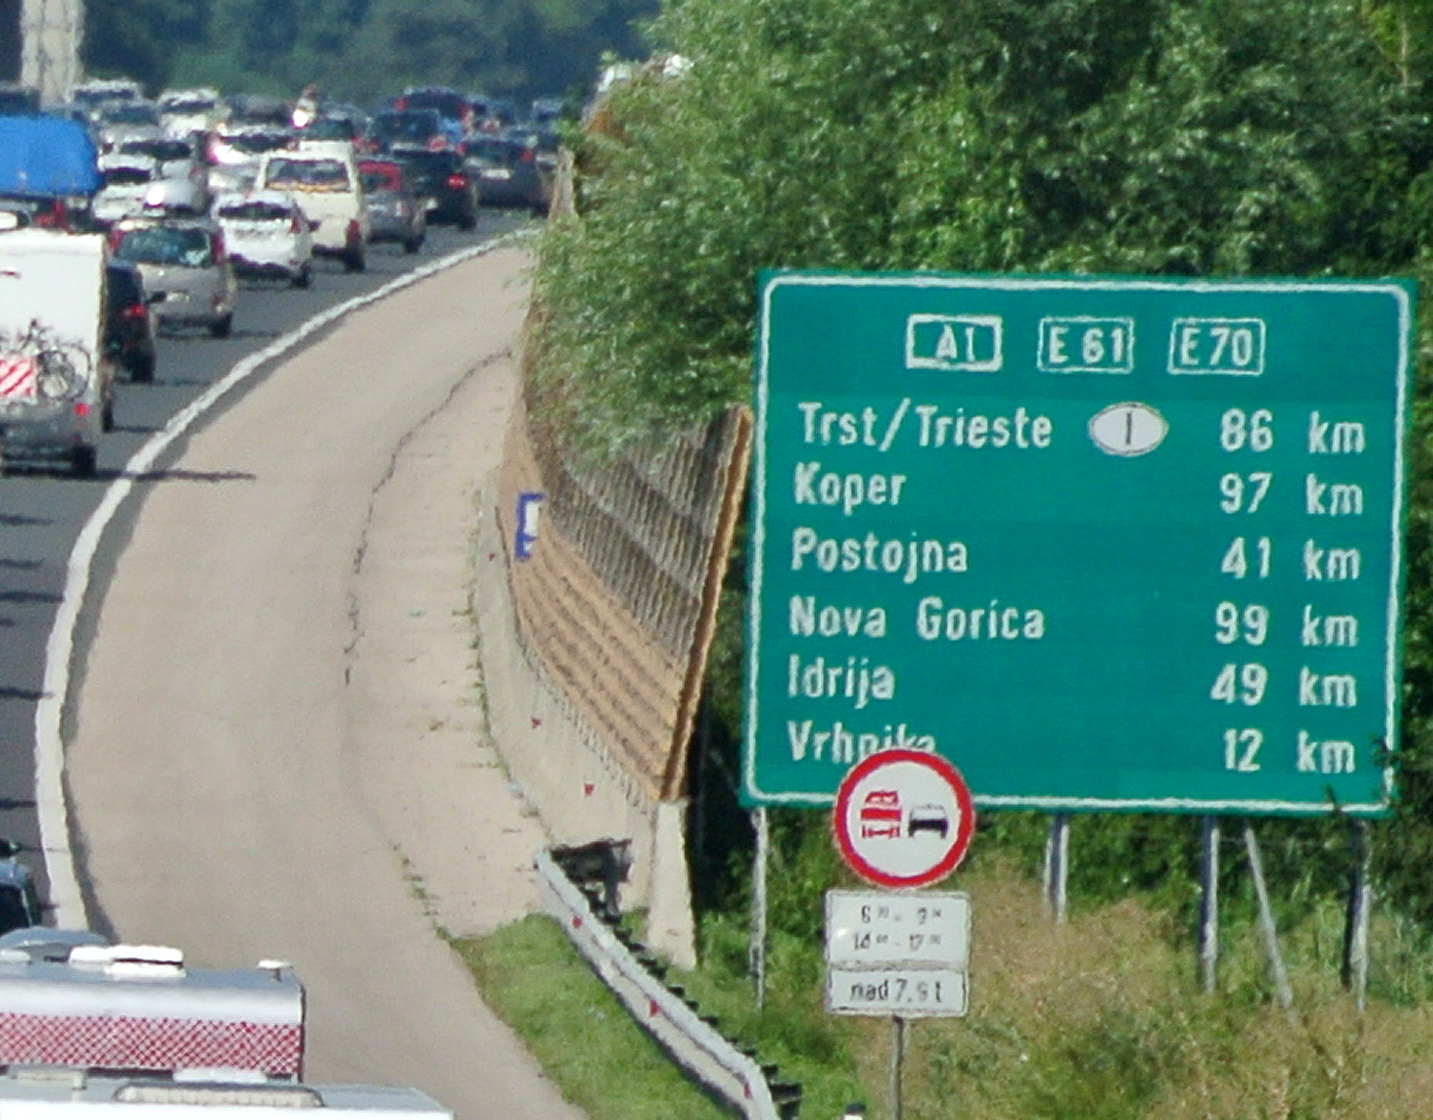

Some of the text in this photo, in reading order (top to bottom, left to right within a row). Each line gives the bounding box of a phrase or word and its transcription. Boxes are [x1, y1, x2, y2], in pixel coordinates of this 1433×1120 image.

[936, 325, 976, 361] A1
[798, 398, 1053, 451] Trst/Trieste
[1220, 408, 1273, 452] 86
[1308, 411, 1365, 454] km
[794, 461, 1363, 516] Koper 97 km
[791, 526, 1360, 584] Postojna 41 km
[789, 594, 1358, 647] Nova Gorica 99 km
[788, 654, 1357, 709] Idrija 49 km
[1224, 728, 1263, 772] 12
[1297, 729, 1355, 773] km
[850, 979, 889, 1001] nad
